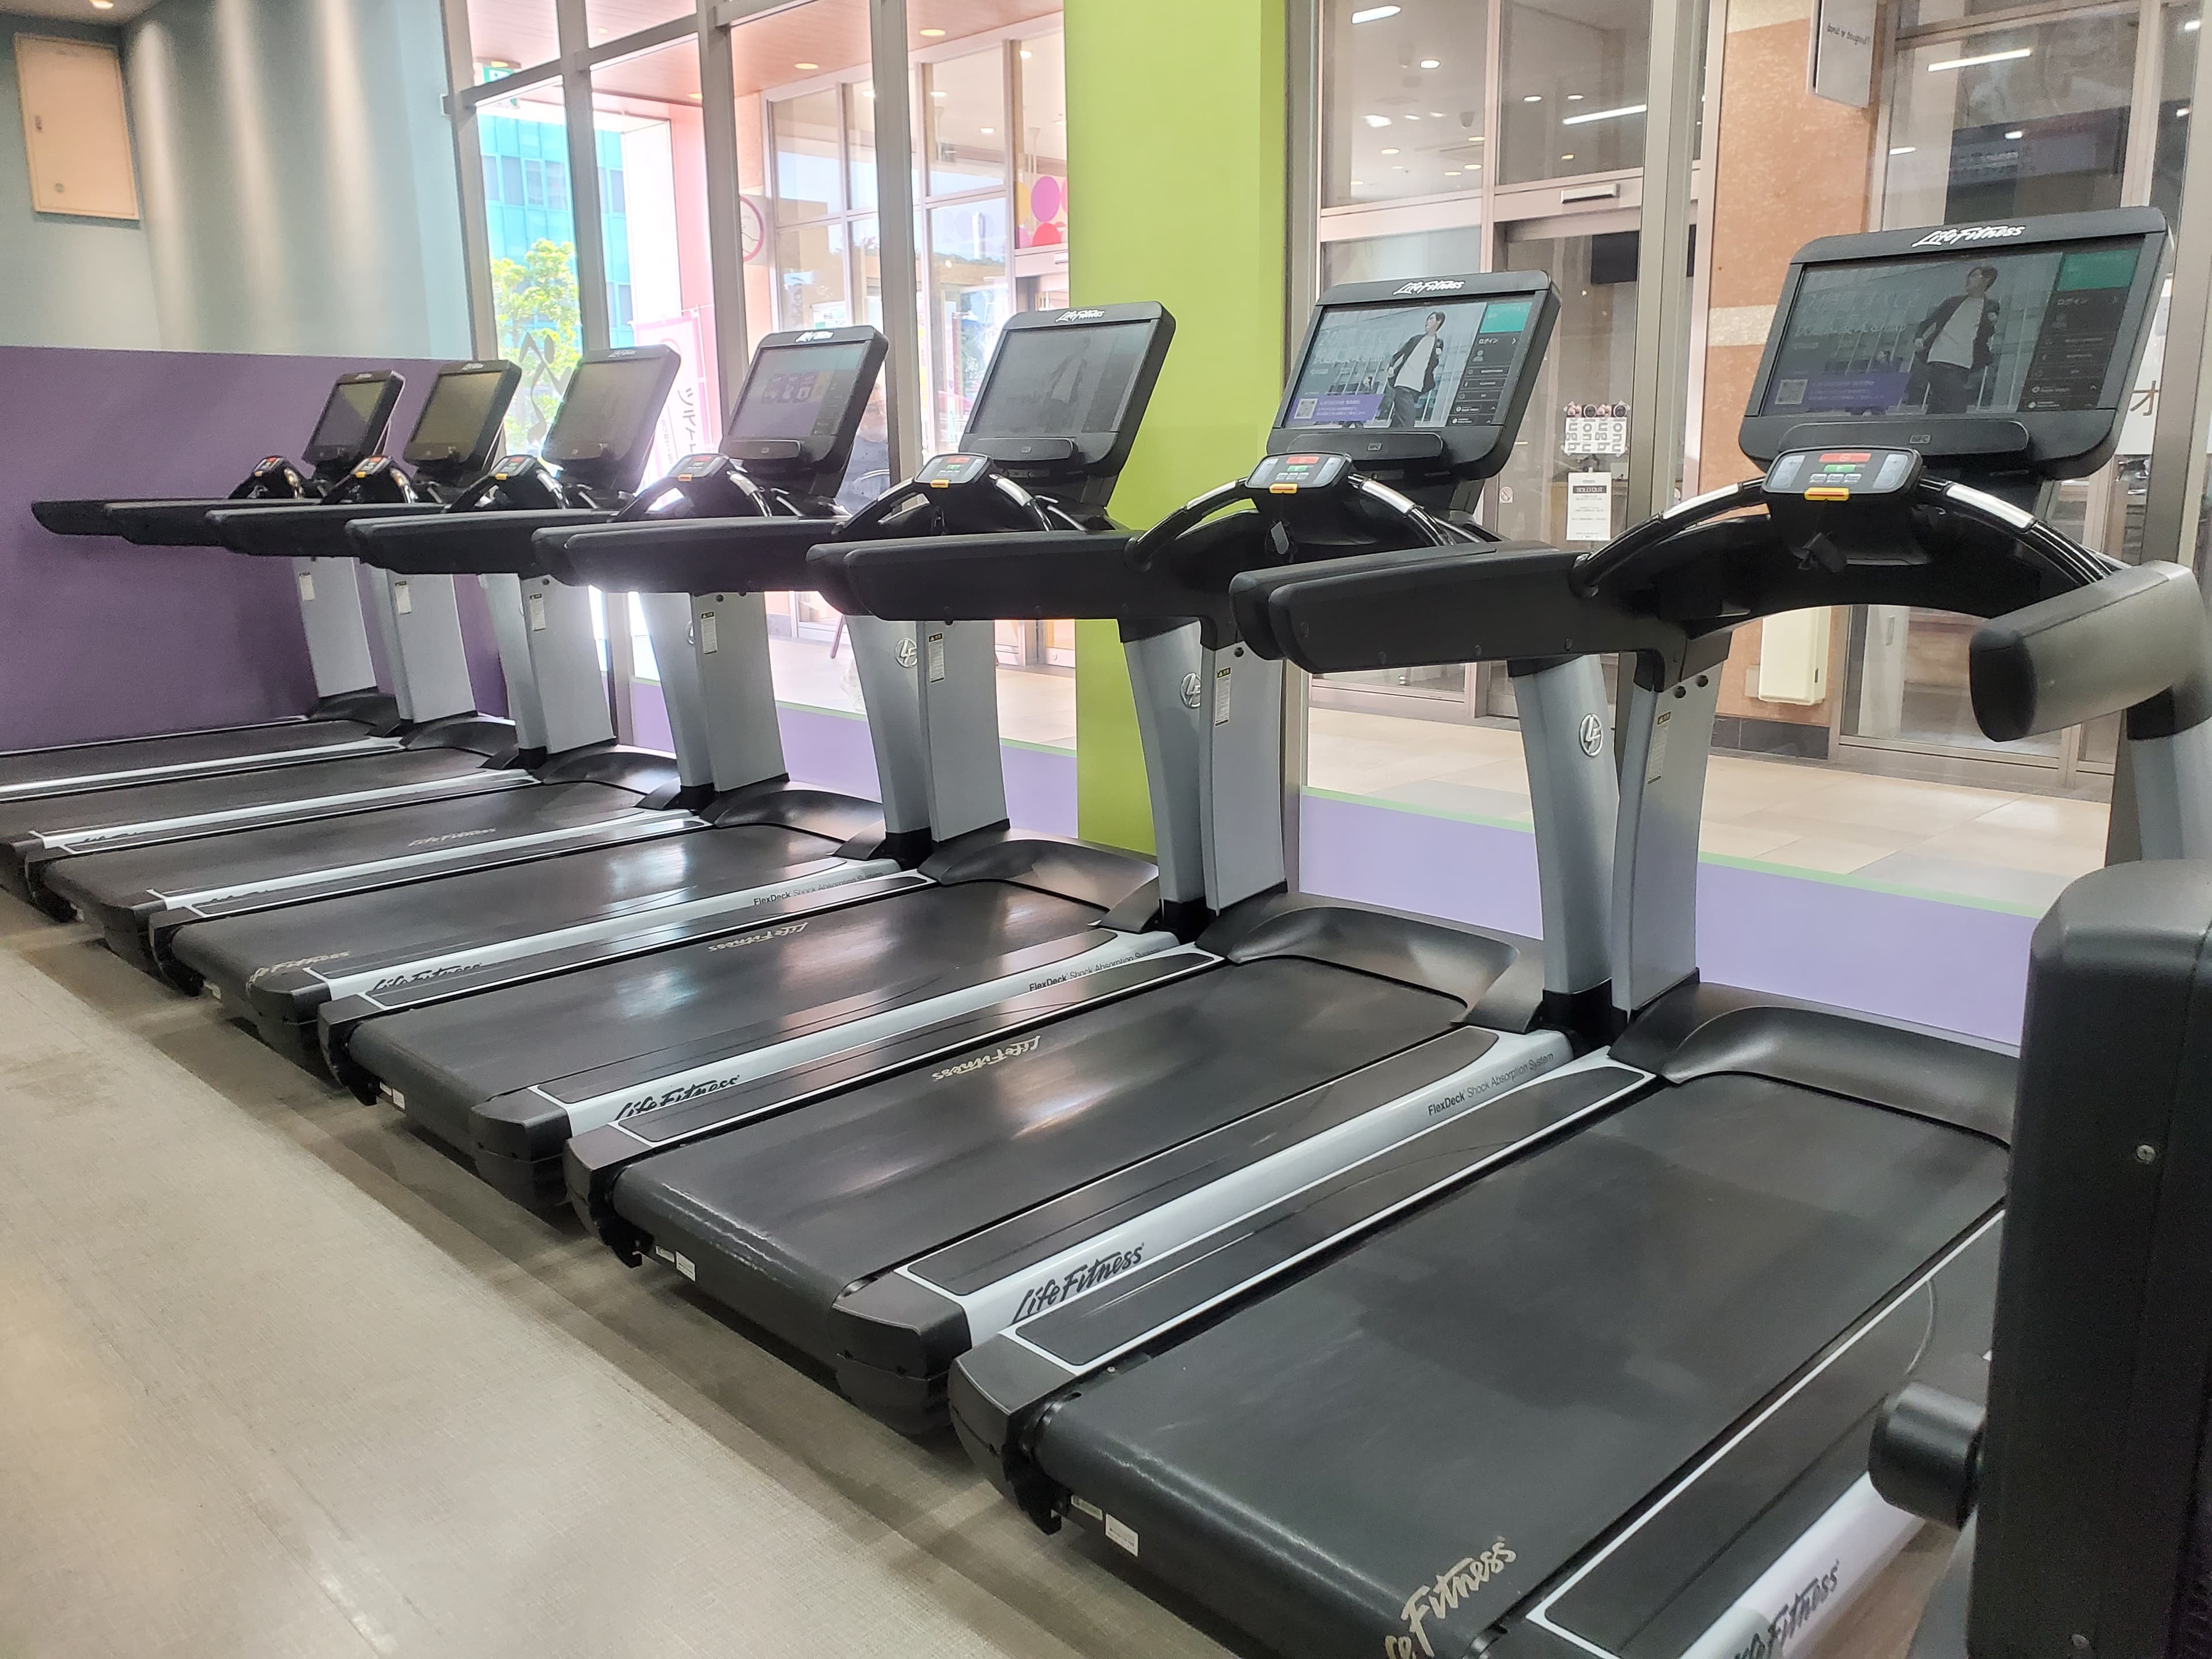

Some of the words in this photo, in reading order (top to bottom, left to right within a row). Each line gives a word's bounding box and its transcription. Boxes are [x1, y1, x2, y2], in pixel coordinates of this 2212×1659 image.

[753, 892, 791, 906] FlexDeck
[1029, 974, 1067, 991] FlexDeck
[1427, 1091, 1465, 1116] FlexDeck
[1467, 1081, 1490, 1099] Shock
[1491, 1063, 1527, 1087] Absorption
[1528, 1052, 1555, 1071] System
[1012, 1279, 1060, 1324] Life
[1060, 1245, 1143, 1302] Fitness
[1400, 1541, 1517, 1657] Fitness
